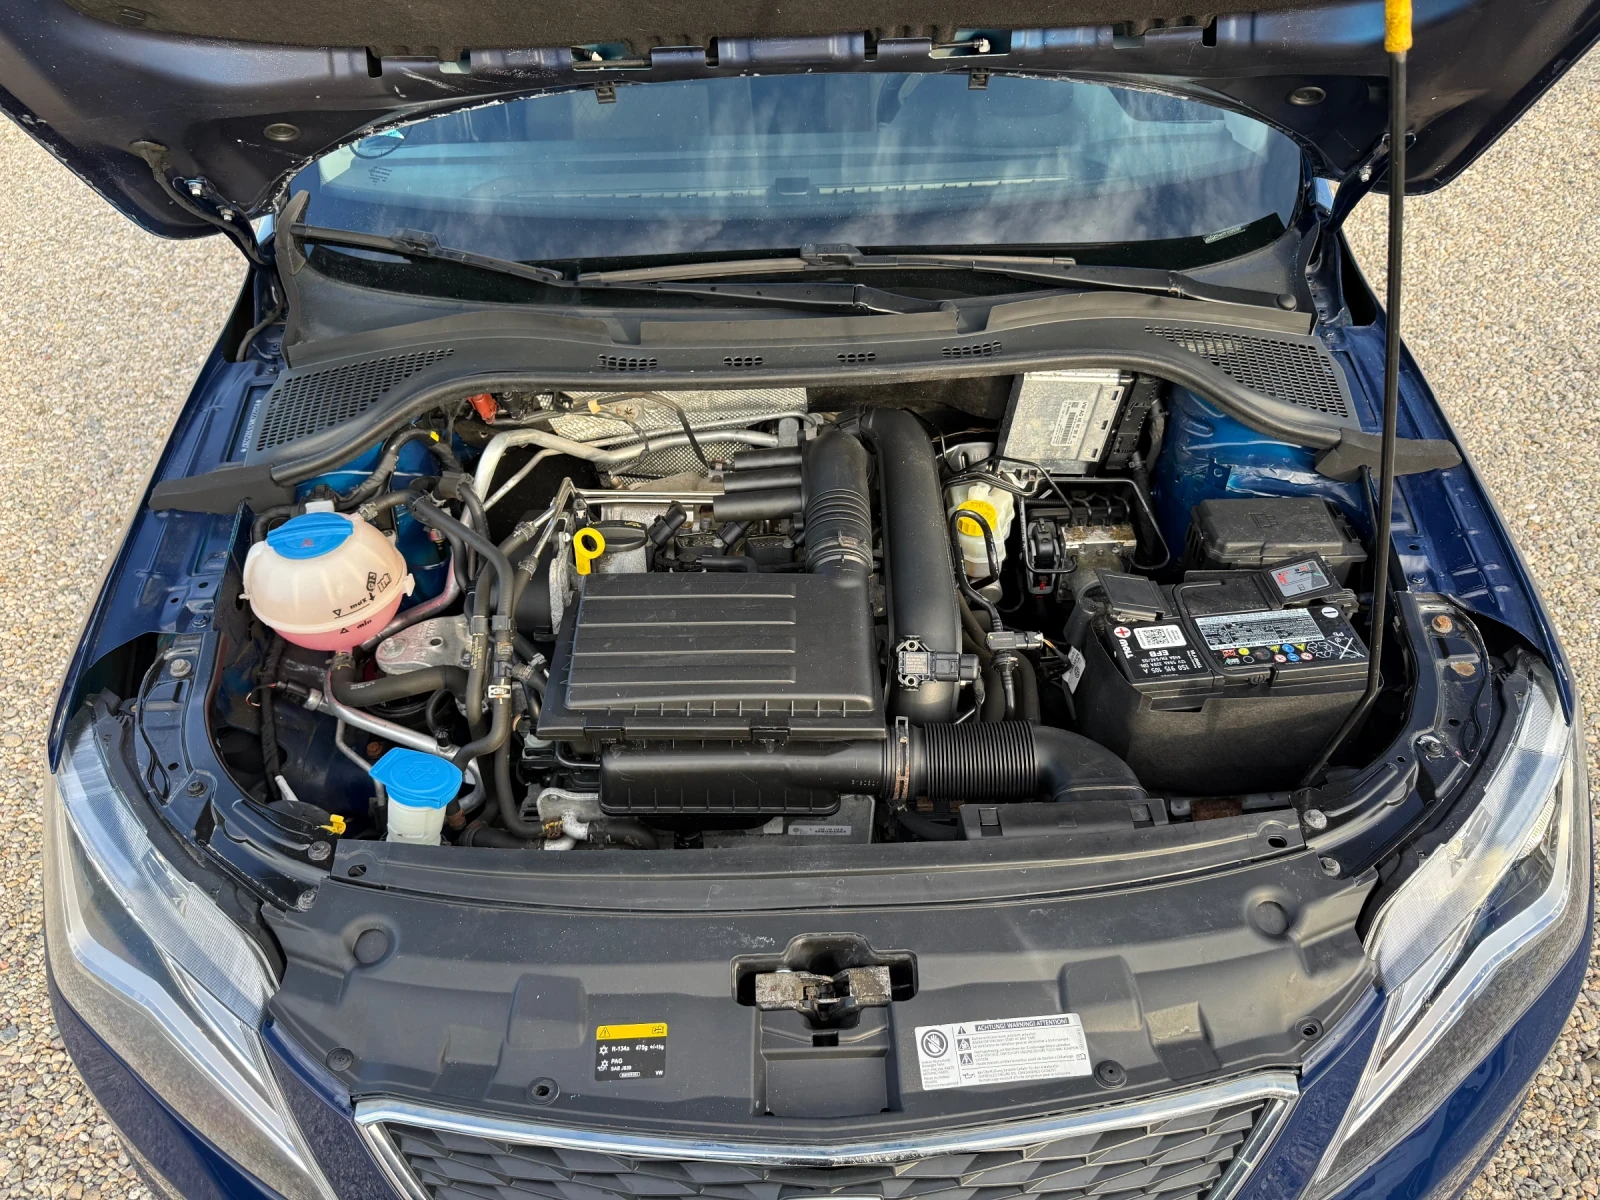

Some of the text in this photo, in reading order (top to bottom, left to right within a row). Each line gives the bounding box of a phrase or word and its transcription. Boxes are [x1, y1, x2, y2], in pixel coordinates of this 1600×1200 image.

[350, 597, 368, 609] max
[1148, 649, 1169, 658] EFB
[977, 1017, 1069, 1031] ACHTUNG! WARNING! ATTENTION!
